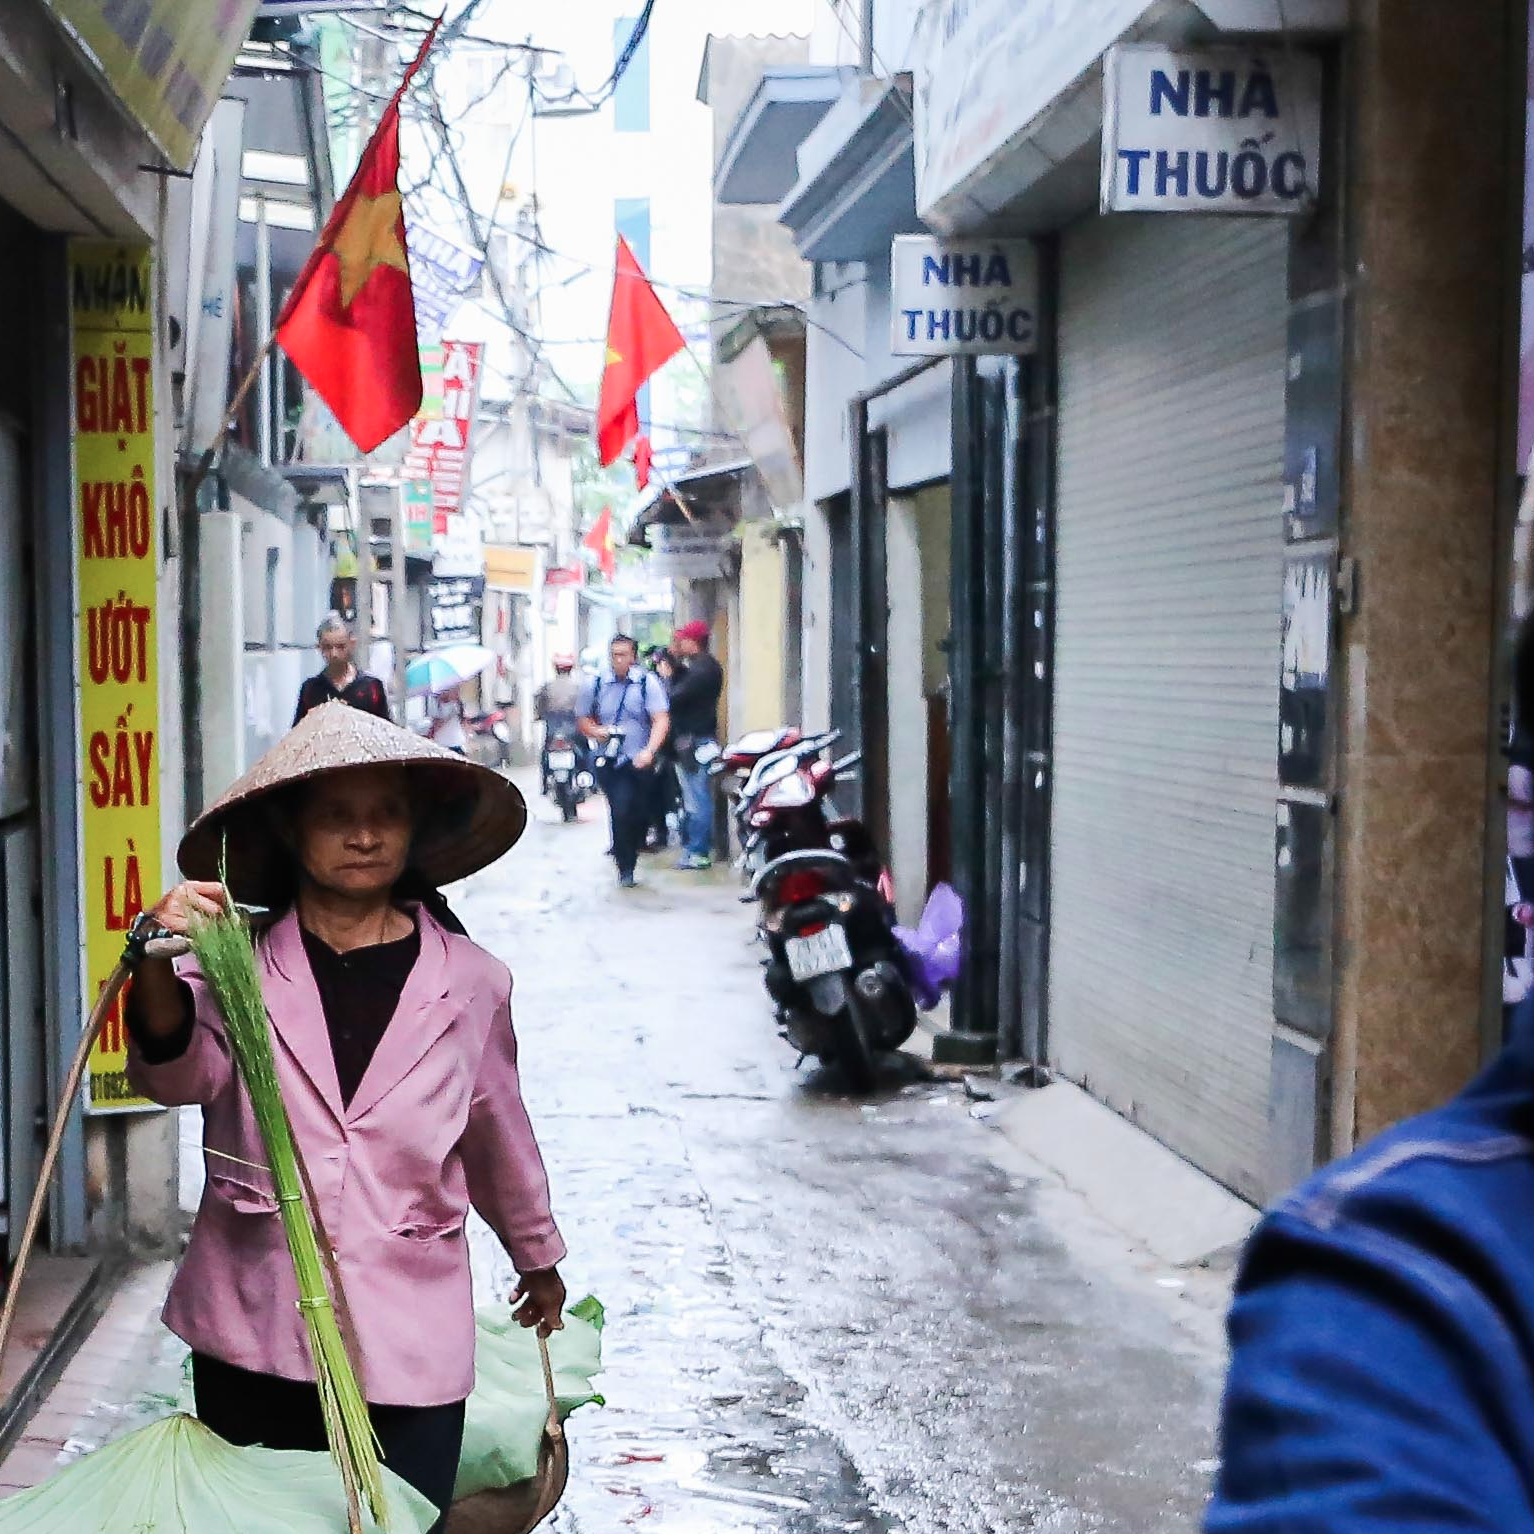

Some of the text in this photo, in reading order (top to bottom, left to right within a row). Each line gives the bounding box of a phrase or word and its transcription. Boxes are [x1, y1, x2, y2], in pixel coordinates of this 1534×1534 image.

[1149, 58, 1280, 117] NHÀ
[1118, 132, 1306, 199] THUỐC
[922, 244, 1012, 288] NHÀ
[901, 296, 1032, 342] THUỐC
[76, 341, 151, 451] GIẶT
[81, 464, 150, 559] KHÔ
[86, 590, 151, 684] ƯỚT
[88, 703, 153, 809] SẤY
[104, 839, 144, 931] LÀ
